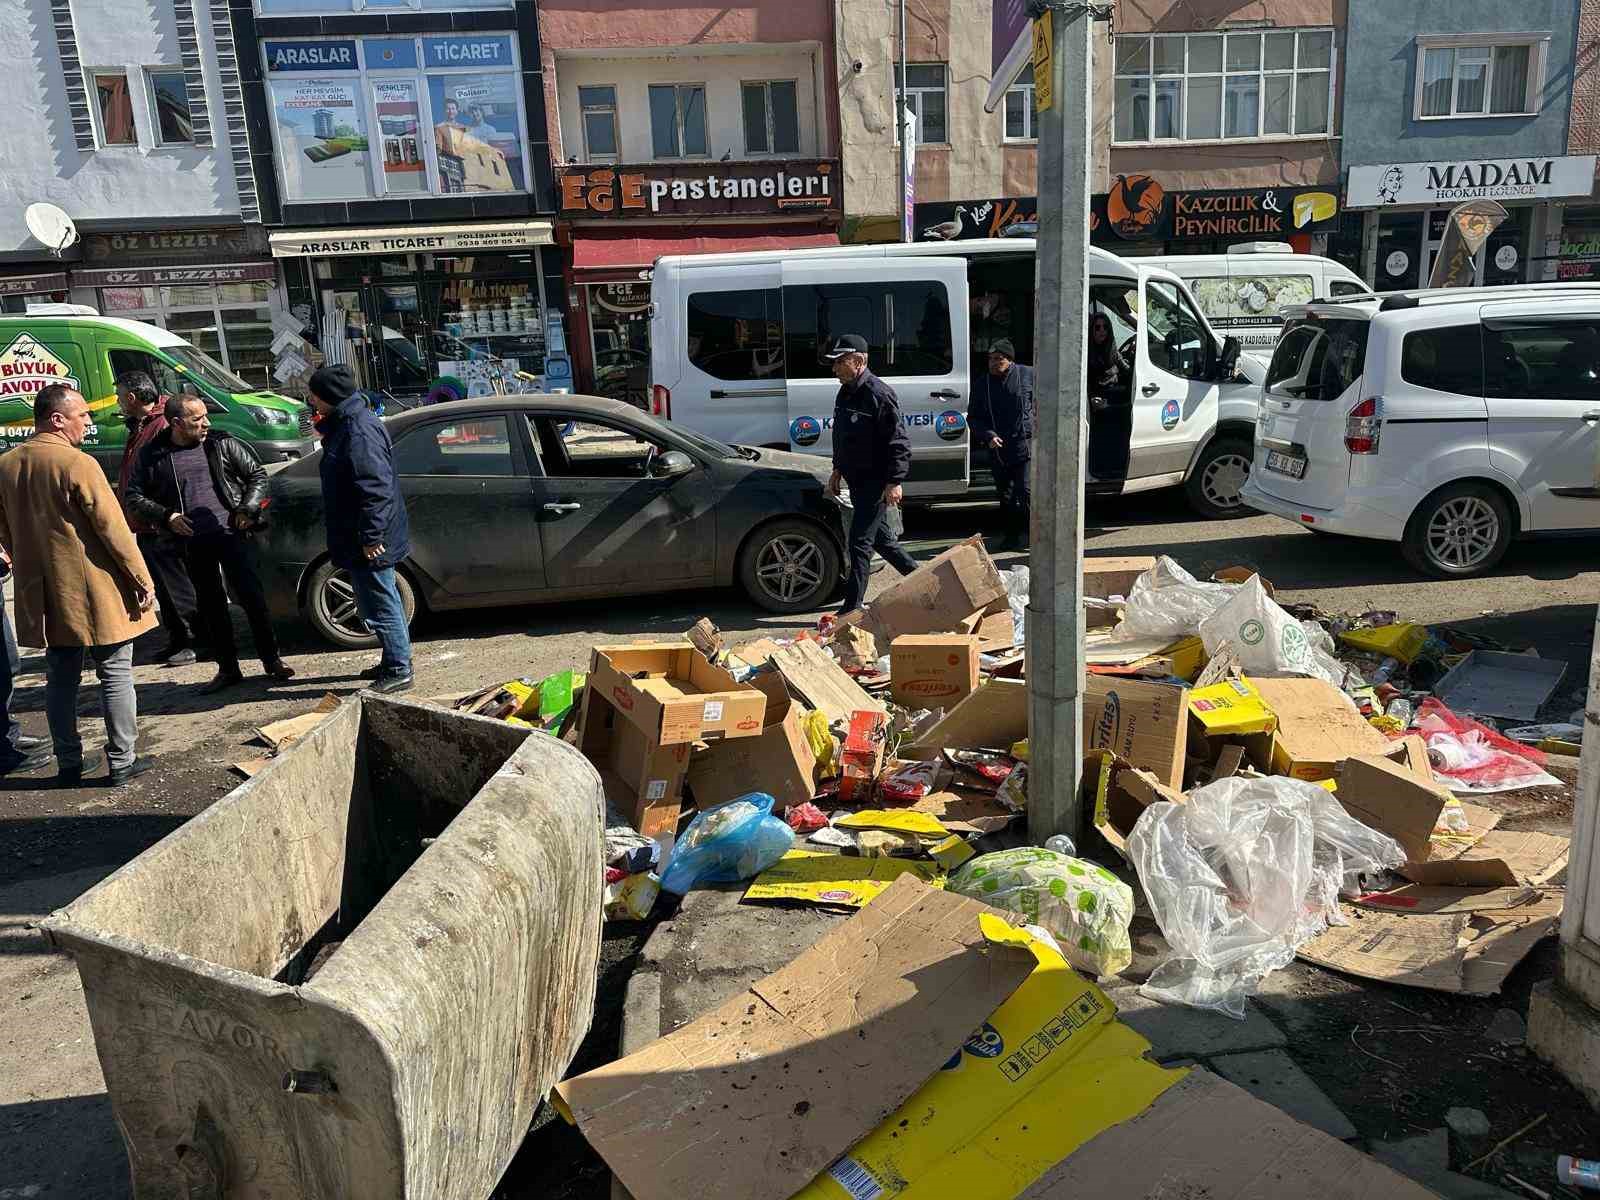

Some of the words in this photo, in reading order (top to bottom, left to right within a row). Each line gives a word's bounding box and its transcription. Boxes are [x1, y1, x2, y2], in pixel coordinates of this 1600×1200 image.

[275, 46, 351, 65] ARASLAR
[434, 41, 500, 60] TİCARET
[1425, 160, 1555, 190] MADAM
[651, 170, 829, 212] pastaneleri
[1436, 188, 1486, 199] HOOKAH
[1489, 185, 1537, 196] LOUNGE
[1175, 194, 1259, 214] KAZCILIK
[1262, 190, 1283, 213] &
[1175, 214, 1282, 237] PEYNİRCİLİK
[112, 236, 139, 249] ÖZ
[151, 233, 219, 249] LEZZET
[301, 240, 370, 253] ARASLAR
[106, 271, 139, 284] ÖZ
[153, 268, 245, 282] LEZZET
[1, 359, 57, 377] BÜYÜK
